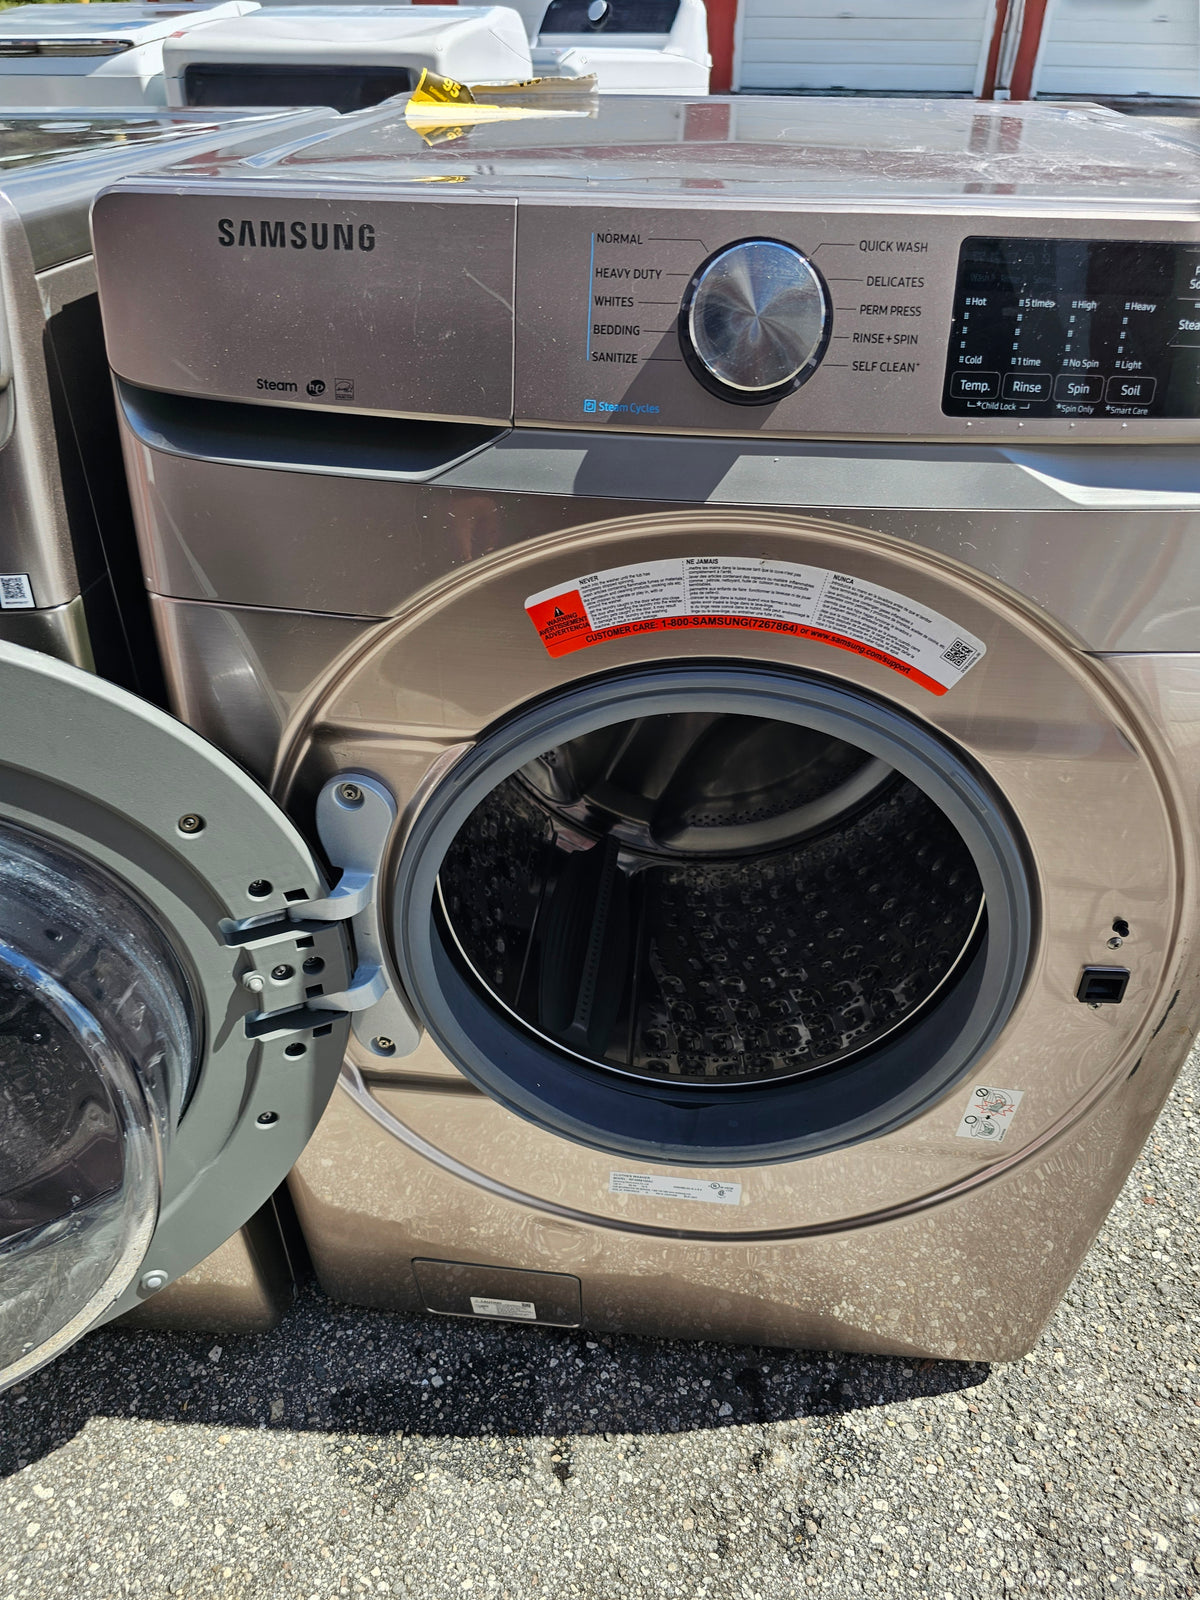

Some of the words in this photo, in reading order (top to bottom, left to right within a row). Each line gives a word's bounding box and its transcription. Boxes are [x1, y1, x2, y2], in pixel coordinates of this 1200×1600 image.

[442, 77, 461, 98] 95
[218, 218, 376, 252] SAMSUNG
[597, 233, 643, 245] NORMAL
[859, 240, 894, 252] QUICK
[896, 242, 928, 252] WASH
[596, 268, 631, 278] HEAVY
[634, 268, 662, 279] DUTY
[867, 276, 924, 288] DELICATES
[595, 296, 634, 307] WHITES
[971, 297, 988, 306] Hot
[1025, 298, 1031, 308] 5
[1077, 300, 1097, 311] High
[860, 305, 888, 315] PERM
[890, 305, 921, 316] PRESS
[1131, 302, 1157, 313] Heavy
[594, 325, 640, 336] BEDDING
[592, 352, 638, 364] SANITIZE
[964, 355, 983, 365] Cold
[1016, 357, 1022, 366] 1
[1023, 357, 1041, 367] time
[852, 361, 881, 372] SELF
[1069, 358, 1081, 368] No
[1081, 359, 1100, 370] Spin
[1121, 360, 1142, 371] Light
[256, 378, 298, 393] Steam
[960, 379, 991, 394] Temp.
[1012, 380, 1042, 393] Rinse
[1067, 383, 1090, 396] Spin
[1120, 384, 1141, 396] Soil
[598, 401, 628, 412] Steam
[630, 402, 660, 414] Cycles
[1000, 402, 1017, 411] Lock
[1076, 405, 1095, 415] Only
[1132, 407, 1149, 415] Care
[685, 558, 695, 566] NE
[579, 575, 600, 586] NEVER
[833, 573, 855, 586] NUNCA
[547, 612, 578, 626] WARNING
[545, 622, 590, 641] ADVERTENCIA
[585, 626, 632, 643] CUSTOMER
[632, 621, 659, 634] CARE:
[661, 616, 798, 634] 1-800-SAMSUNG(7267864)
[800, 627, 810, 635] or
[810, 629, 912, 676] www.samsung.com/support
